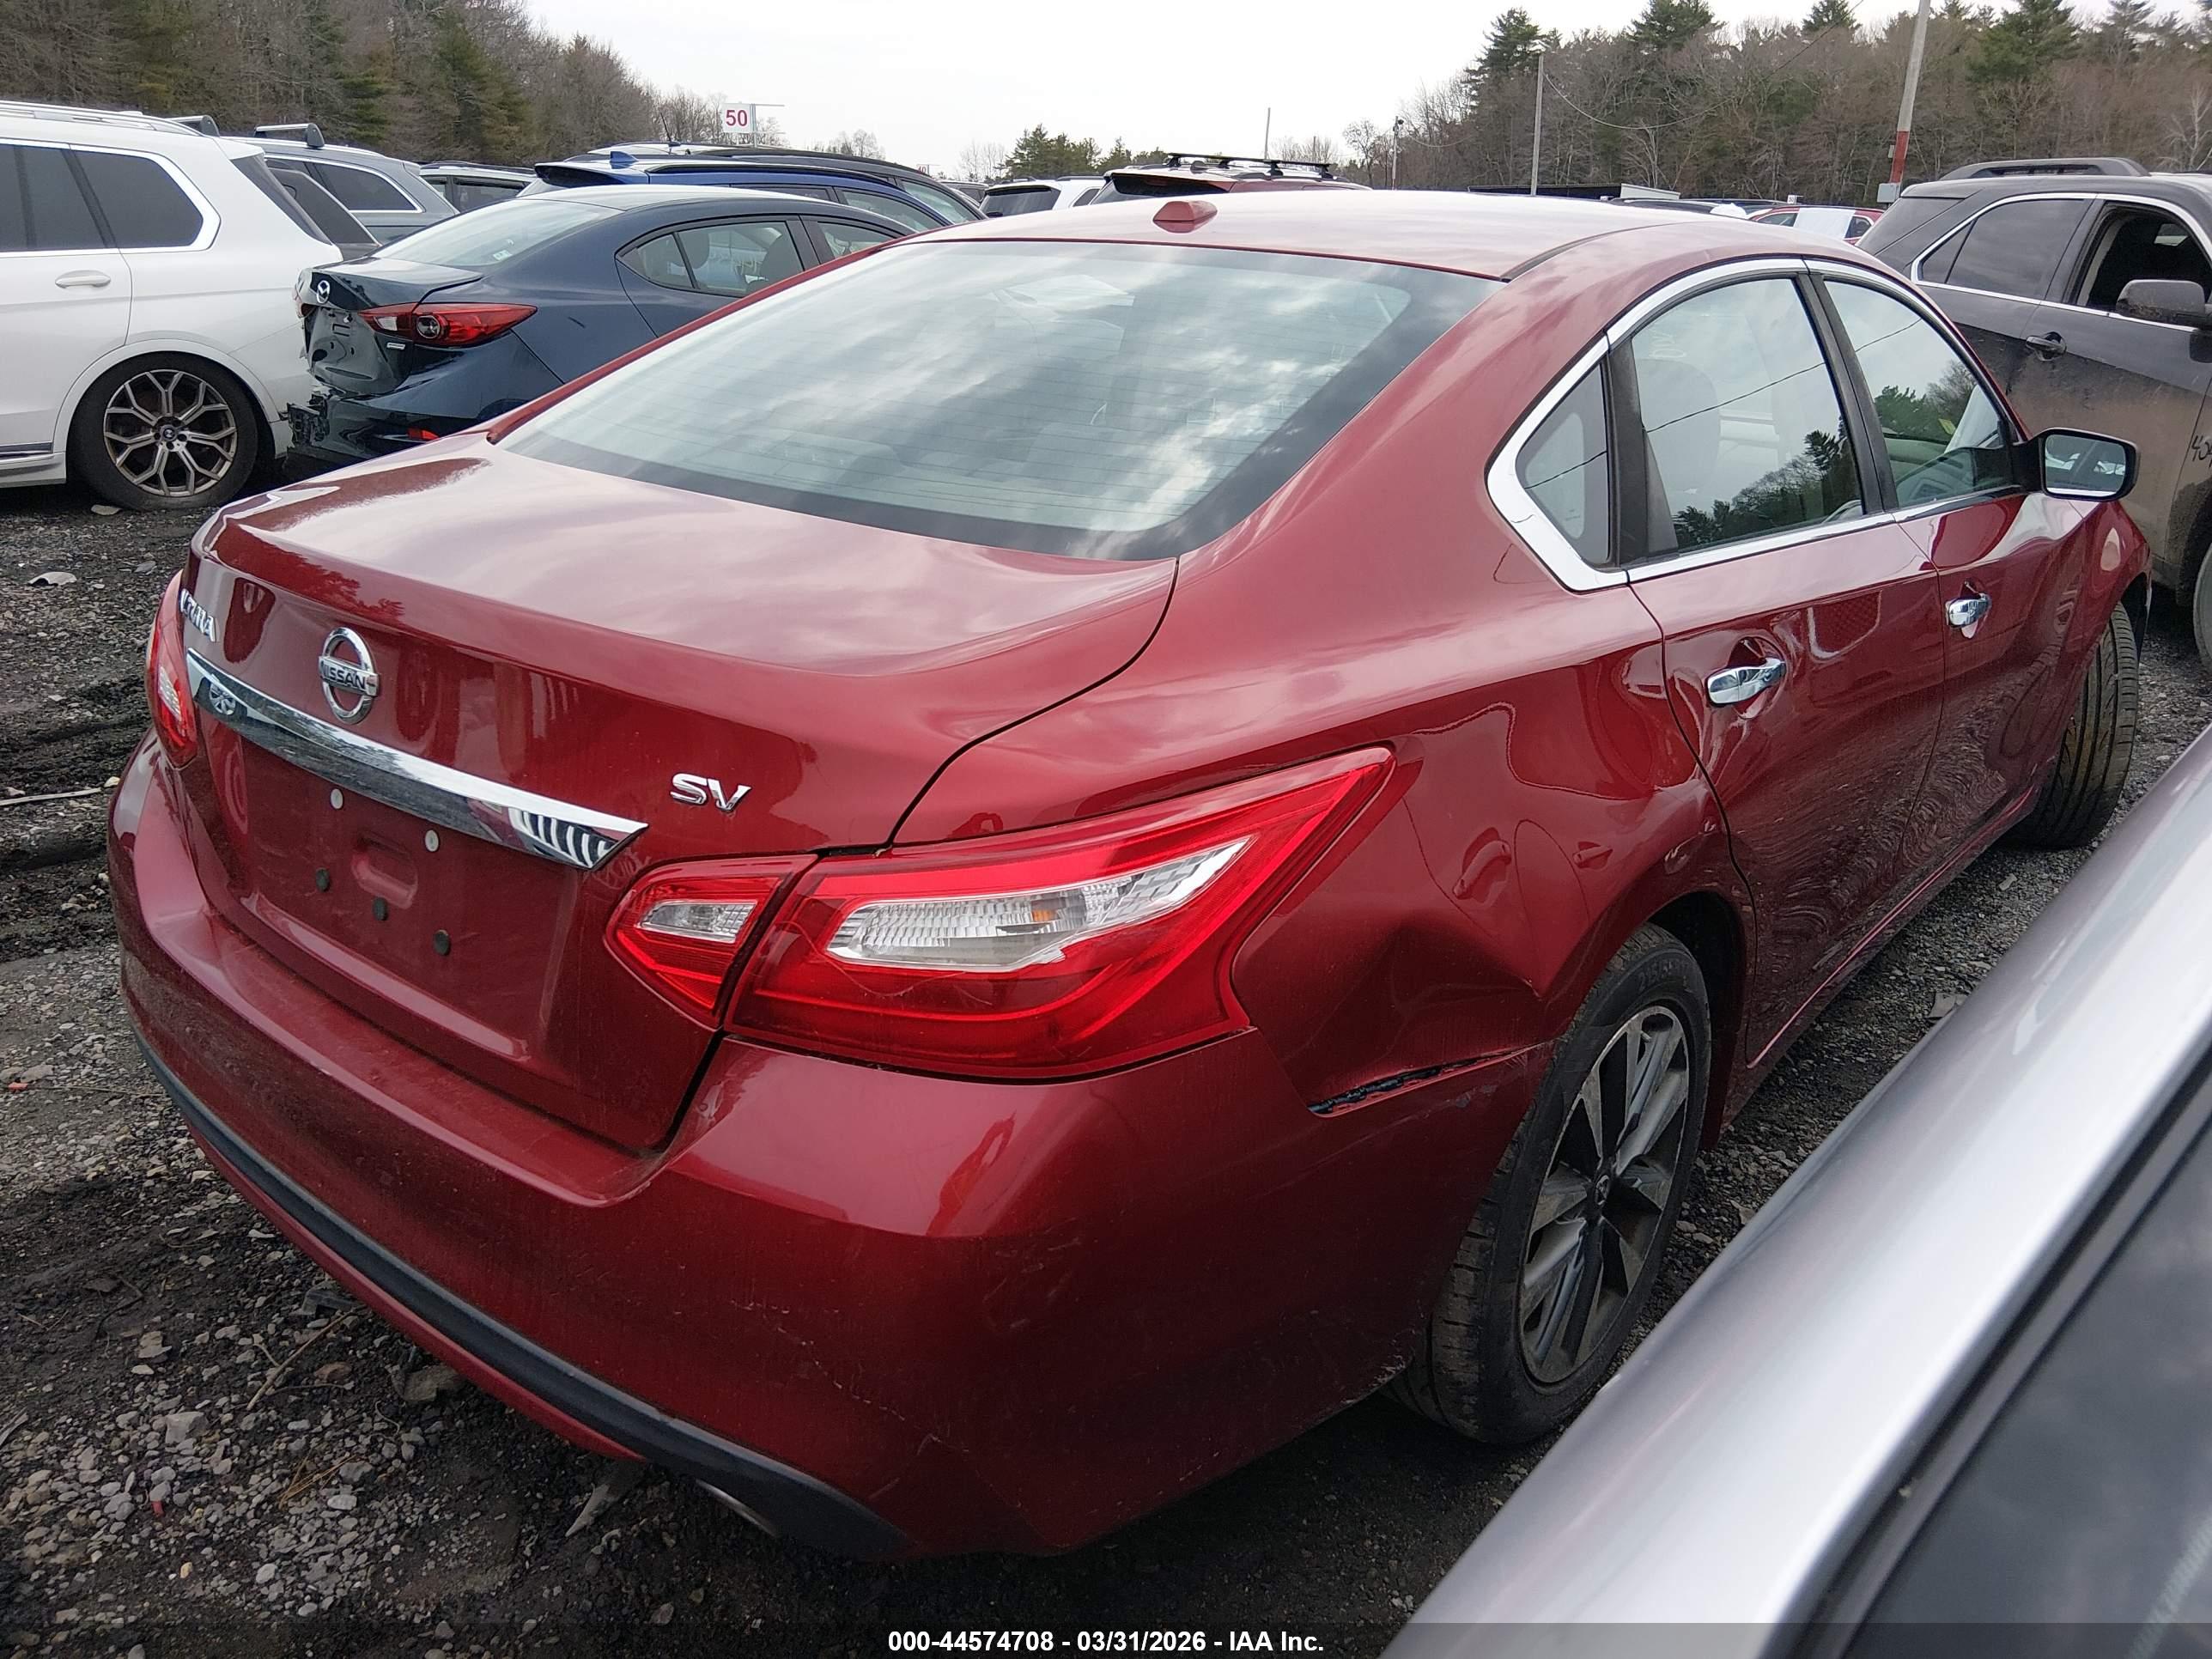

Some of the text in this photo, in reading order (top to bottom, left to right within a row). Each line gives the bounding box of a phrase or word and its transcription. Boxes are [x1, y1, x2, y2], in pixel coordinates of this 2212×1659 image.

[726, 109, 748, 127] 50
[320, 659, 367, 690] NISSAN
[670, 773, 752, 811] SV
